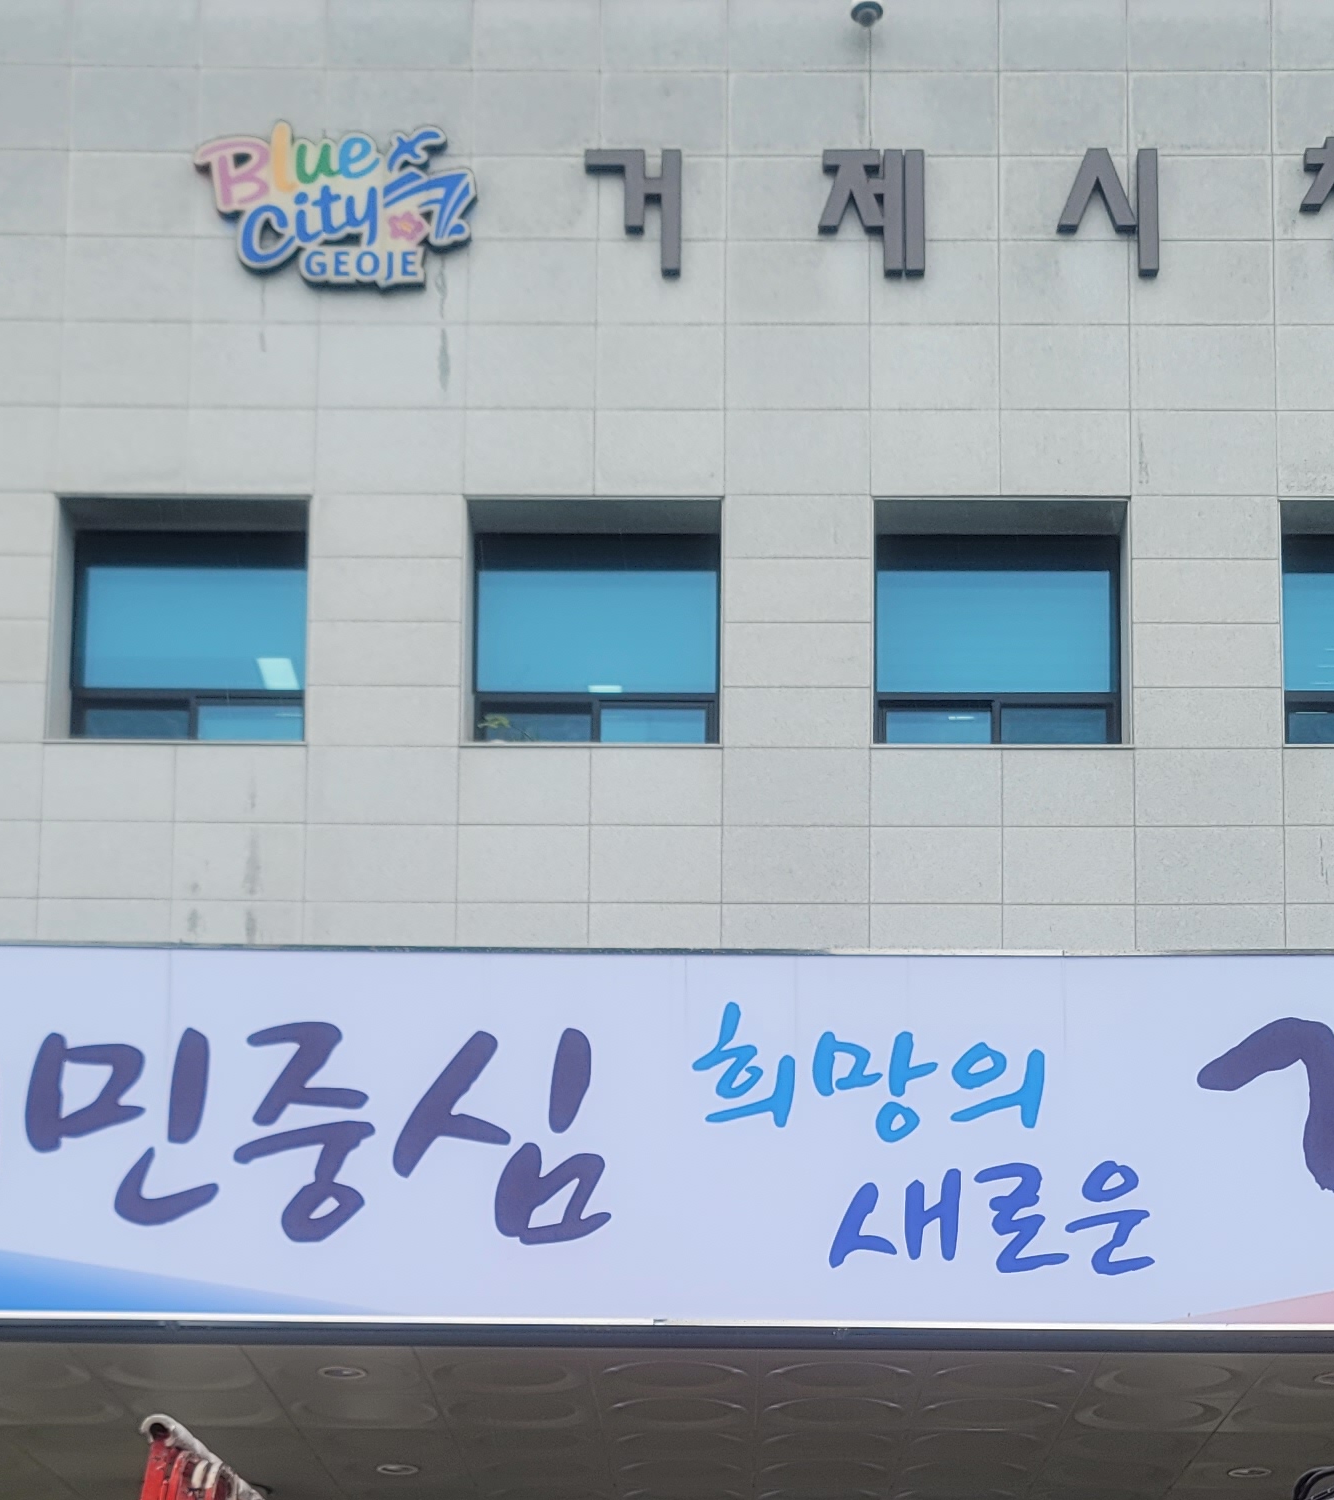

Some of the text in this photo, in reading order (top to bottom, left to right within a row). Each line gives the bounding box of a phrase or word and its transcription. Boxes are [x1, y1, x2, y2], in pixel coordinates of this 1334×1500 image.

[199, 121, 381, 206] Blue
[241, 184, 378, 264] City
[303, 250, 419, 281] GEOJE
[691, 1001, 1046, 1144] 희망의
[828, 1159, 1156, 1277] 새로운
